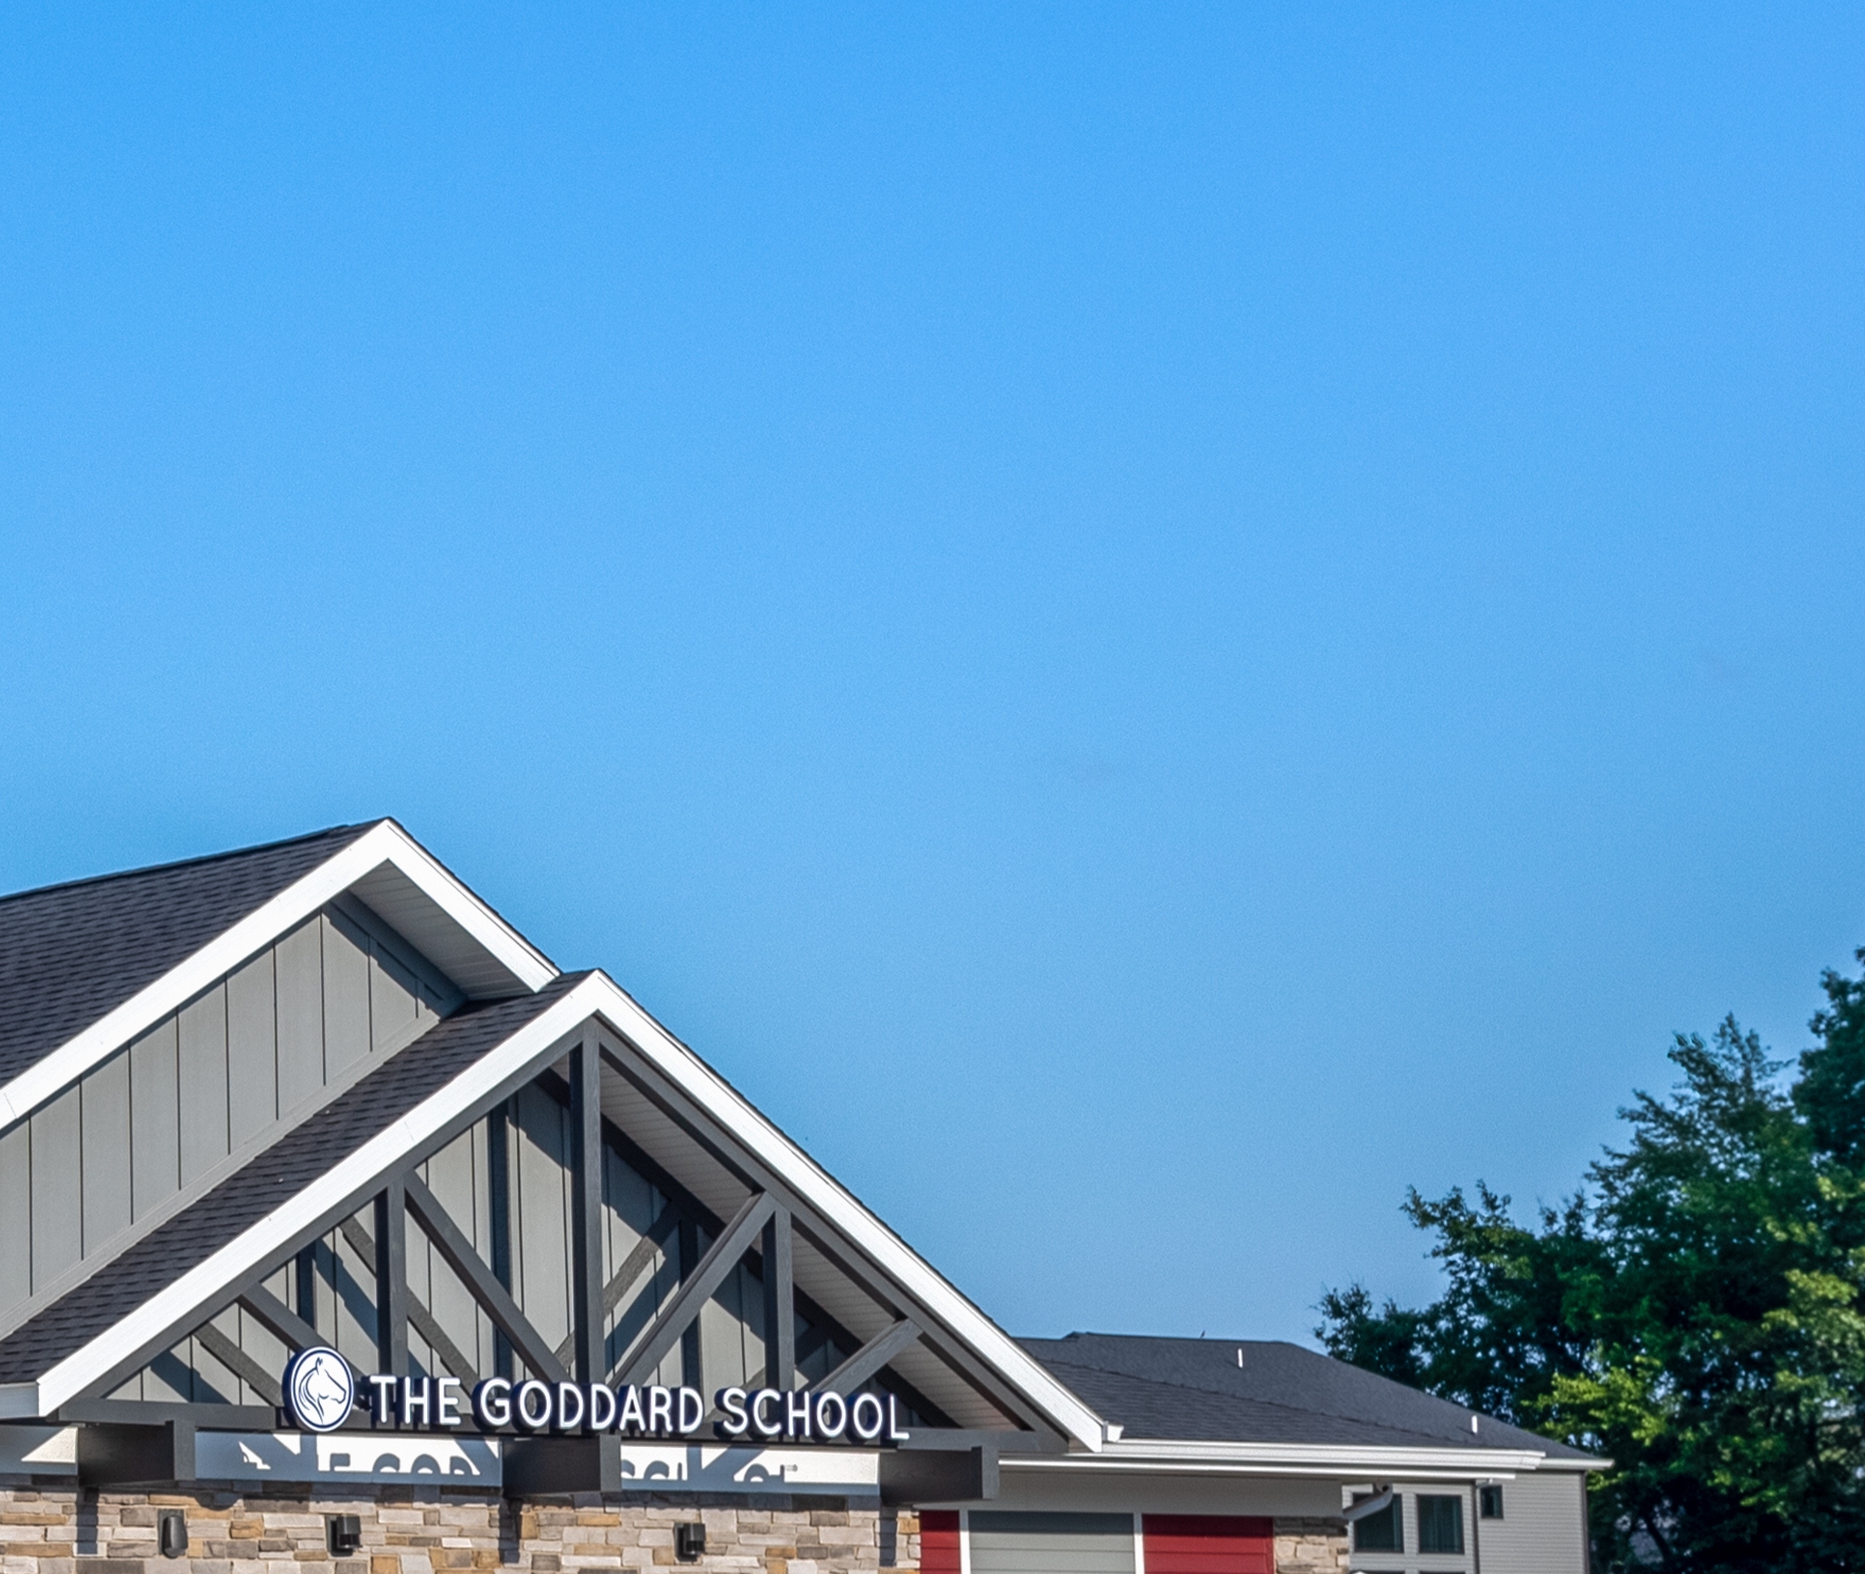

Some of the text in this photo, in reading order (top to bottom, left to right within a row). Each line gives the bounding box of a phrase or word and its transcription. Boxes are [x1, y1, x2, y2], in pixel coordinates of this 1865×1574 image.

[369, 1375, 910, 1440] THE GODDARD SCHOOL
